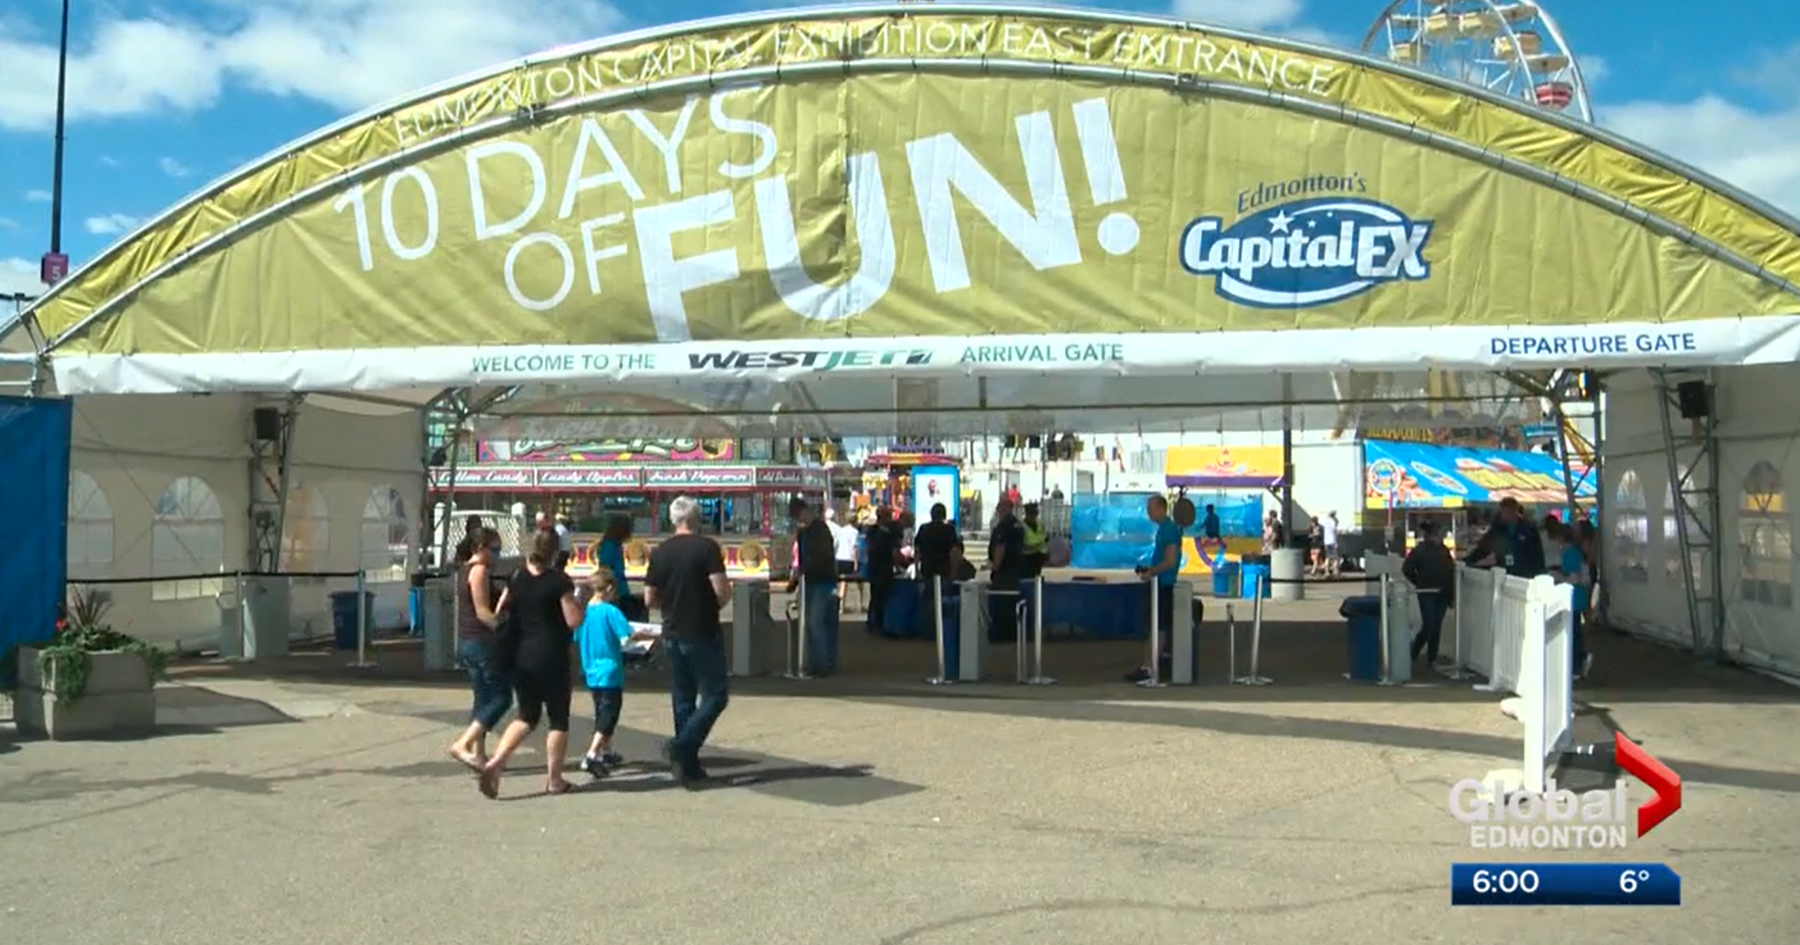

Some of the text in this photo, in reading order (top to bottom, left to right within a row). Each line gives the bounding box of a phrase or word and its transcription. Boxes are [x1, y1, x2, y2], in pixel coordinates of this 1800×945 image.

[395, 21, 1335, 143] EDMONTON CAPITAL EXHIBITION EAST ENTRANCE
[335, 80, 779, 272] 10 DAYS
[1237, 172, 1367, 214] Edmonton's
[503, 96, 1142, 342] OF FUN!
[51, 265, 61, 281] 5
[472, 343, 1124, 373] WELCOME TO THE WESTJET ARRIVAL GATE
[1491, 332, 1696, 354] DEPARTURE GATE
